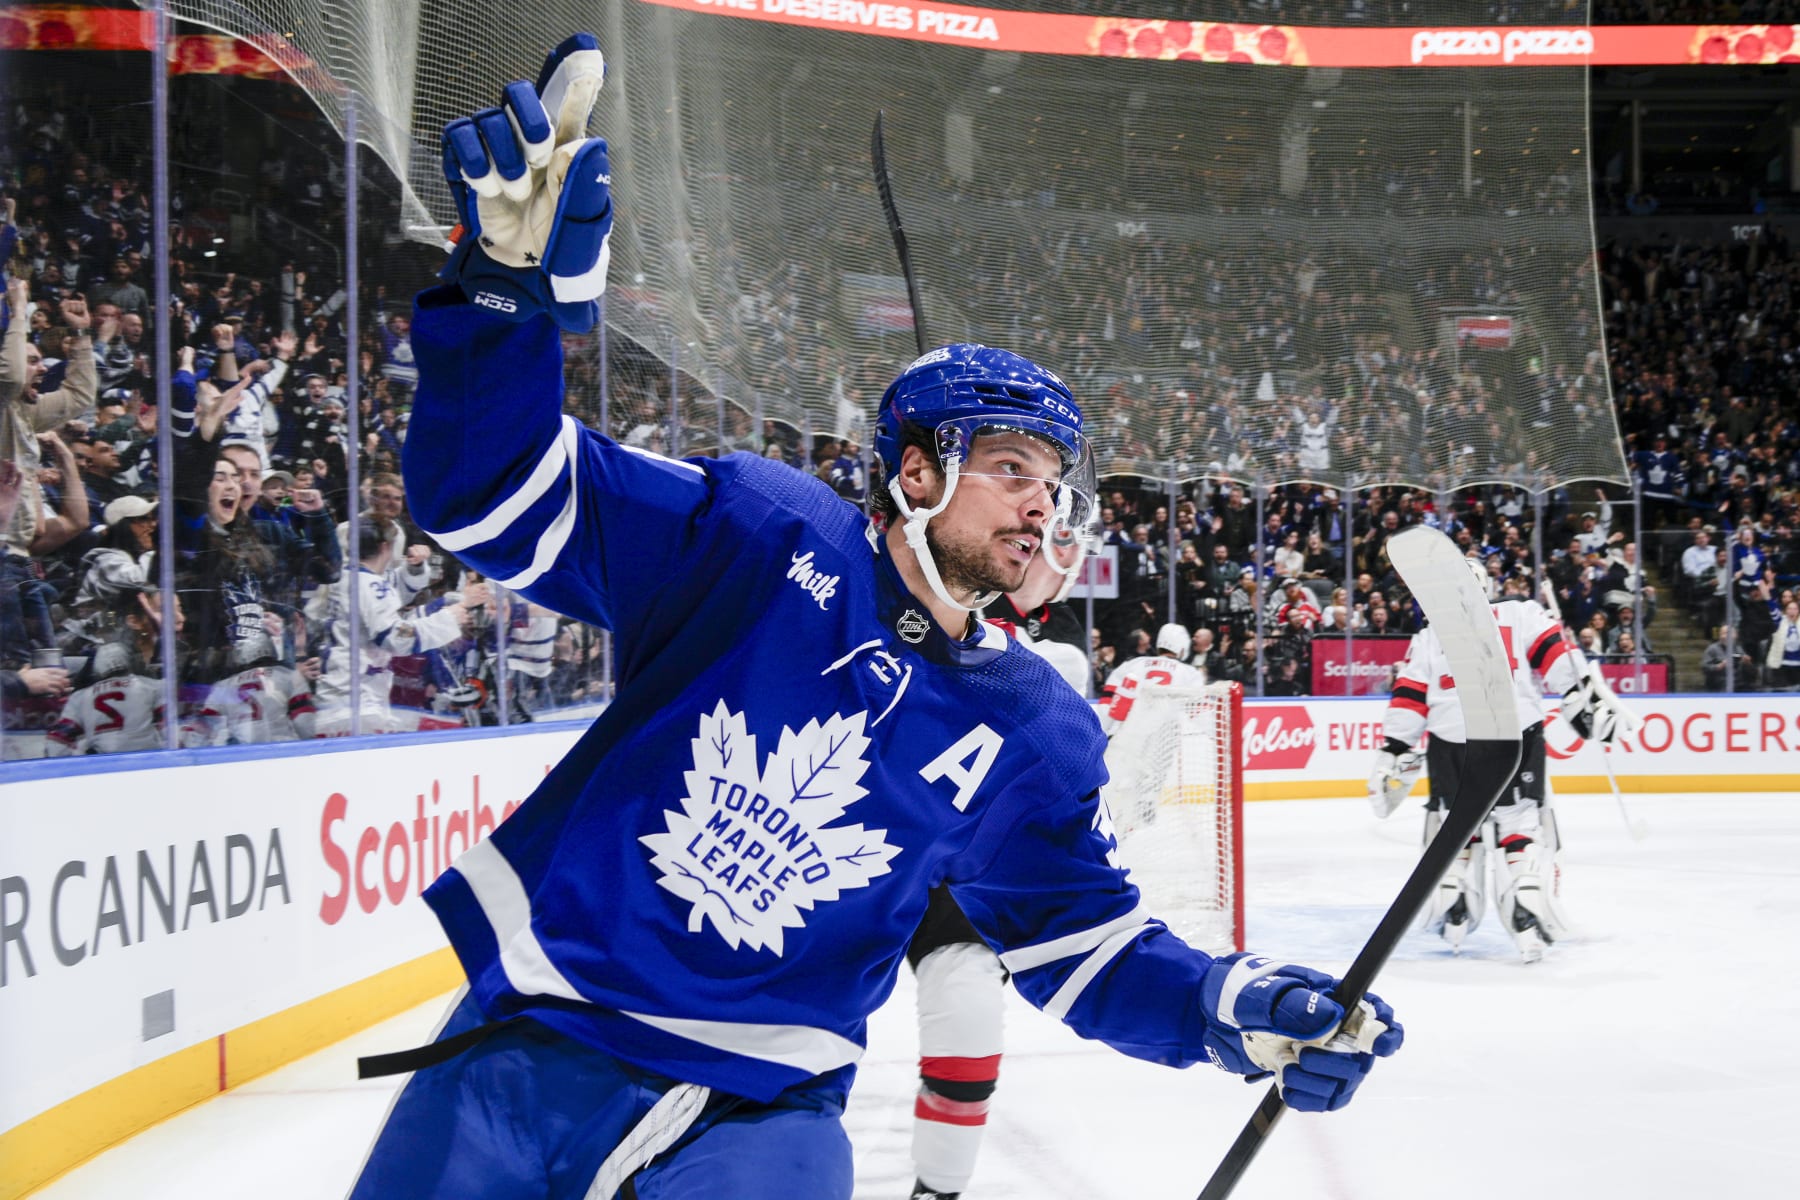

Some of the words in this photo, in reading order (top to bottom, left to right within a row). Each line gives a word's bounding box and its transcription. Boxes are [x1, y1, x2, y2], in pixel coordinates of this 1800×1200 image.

[763, 0, 913, 30] DESERVES
[917, 10, 999, 40] PIZZA
[1411, 31, 1500, 64] pizza
[1503, 30, 1594, 63] pizza
[1731, 225, 1762, 240] 107
[474, 295, 517, 313] CCM
[1043, 396, 1079, 424] CCM
[940, 451, 960, 459] CCM
[786, 551, 840, 610] Milk
[1328, 722, 1385, 751] EVER
[1604, 712, 1800, 754] OGER
[918, 722, 1004, 813] A
[319, 764, 551, 925] Scotiab
[705, 809, 798, 892] MAPLE
[709, 776, 831, 885] TORONTO
[686, 832, 777, 913] LEAFS
[49, 827, 291, 967] CANADA
[1306, 991, 1320, 1014] CC
